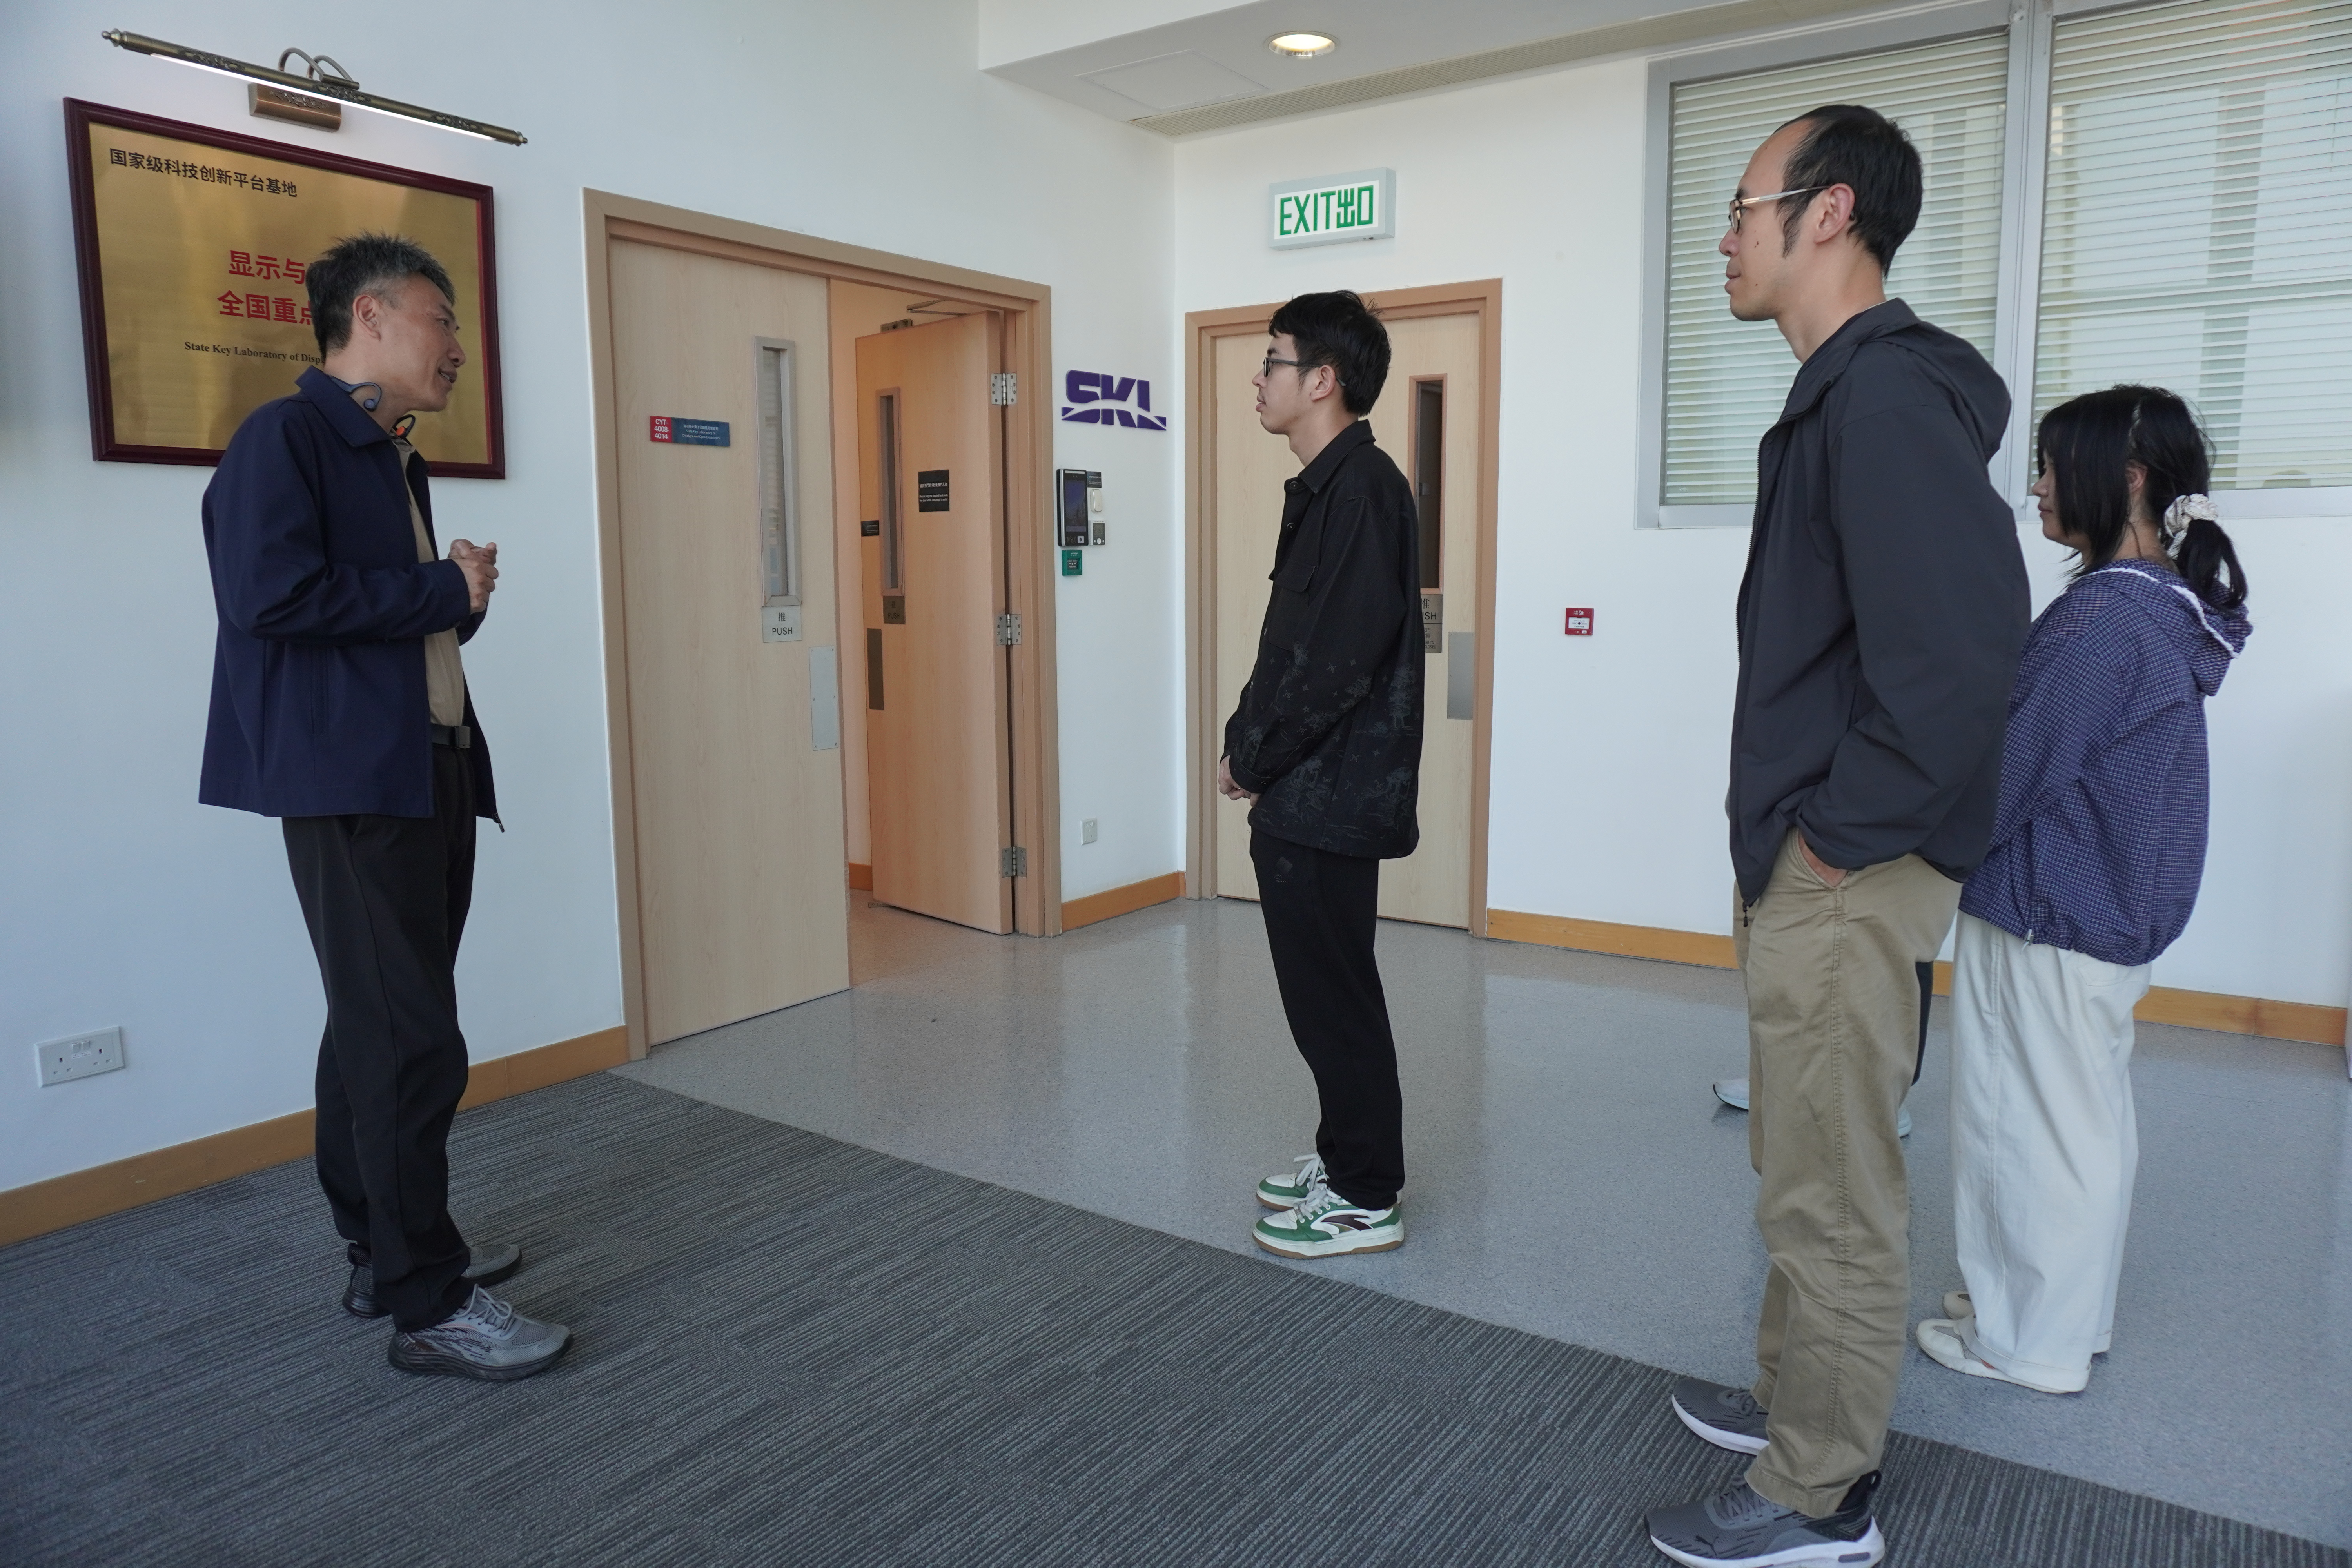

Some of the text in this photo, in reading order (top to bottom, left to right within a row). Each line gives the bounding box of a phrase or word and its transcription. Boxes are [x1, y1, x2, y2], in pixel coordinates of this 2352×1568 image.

[110, 148, 298, 197] 国家级科技创新平台基地
[1279, 185, 1374, 236] EXIT 出口
[228, 250, 305, 285] 显示与
[185, 341, 210, 352] State
[212, 344, 231, 356] Key
[234, 346, 287, 362] Laboratory
[290, 353, 299, 361] of
[772, 627, 792, 635] PUSH
[778, 612, 786, 622] 推
